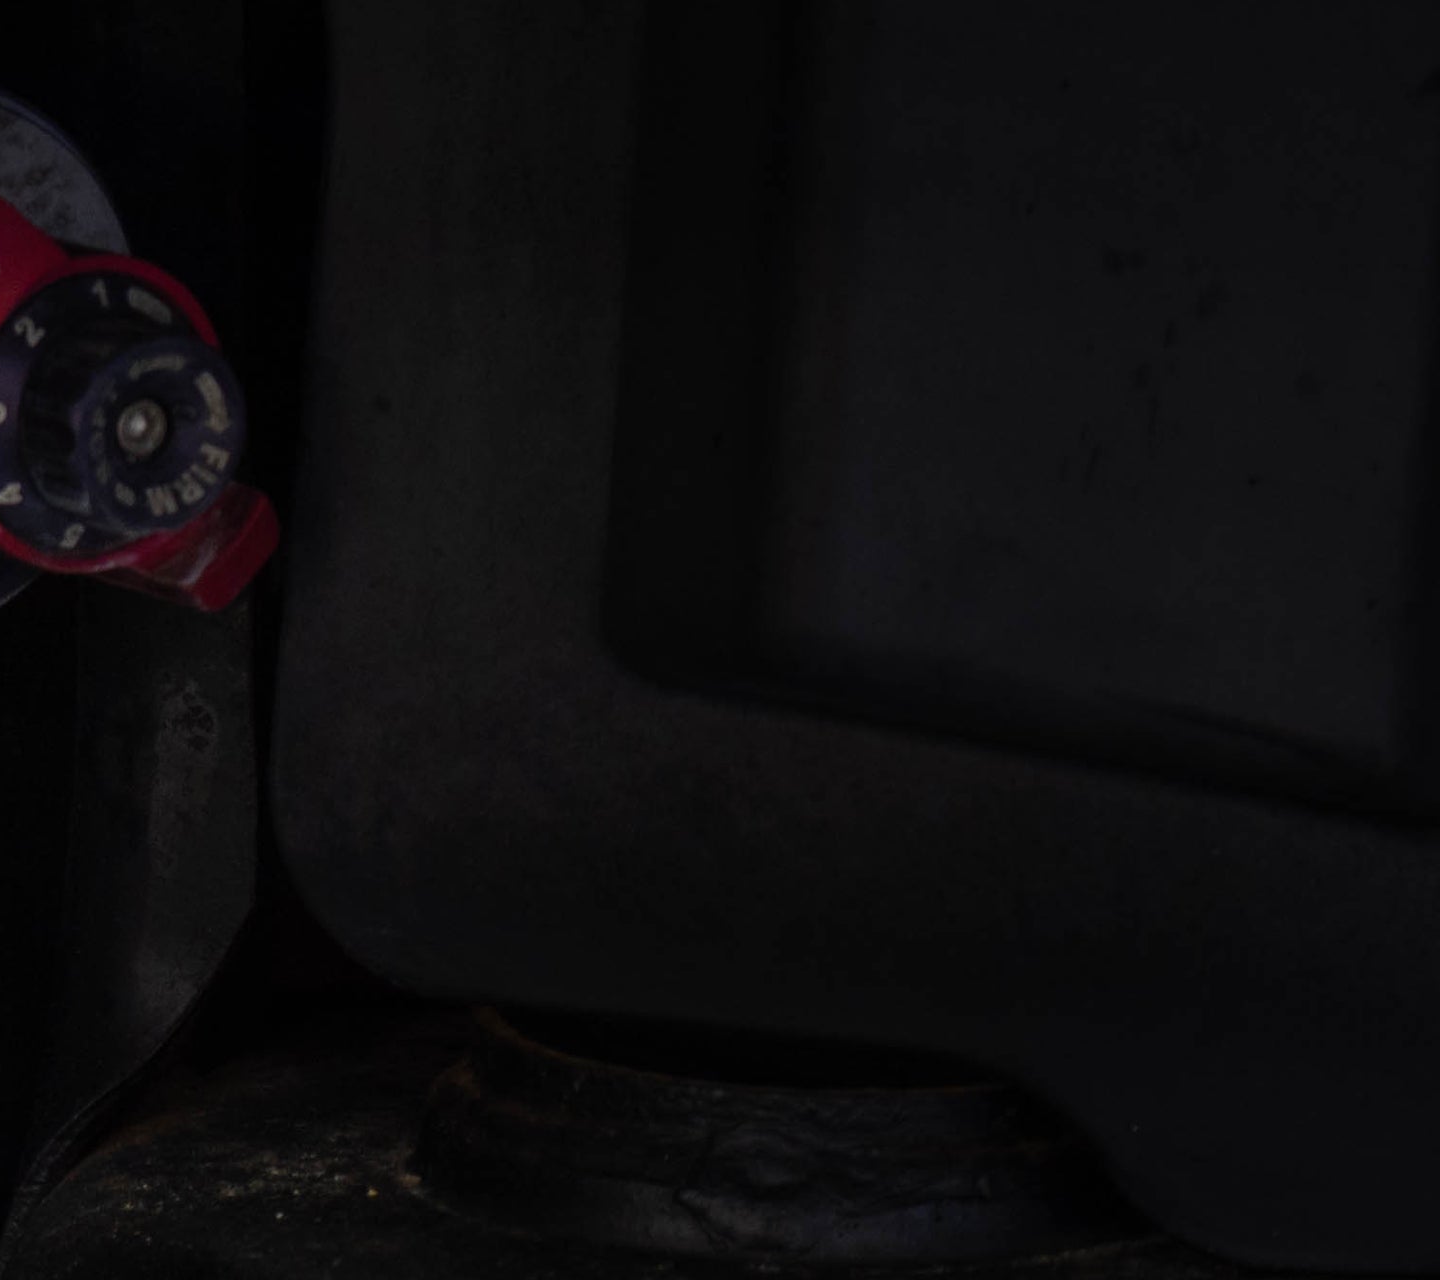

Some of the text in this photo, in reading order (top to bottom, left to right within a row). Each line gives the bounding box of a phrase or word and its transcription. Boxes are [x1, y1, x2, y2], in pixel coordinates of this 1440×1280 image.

[91, 277, 110, 310] 1
[13, 315, 46, 348] 2
[144, 442, 231, 518] FIRM
